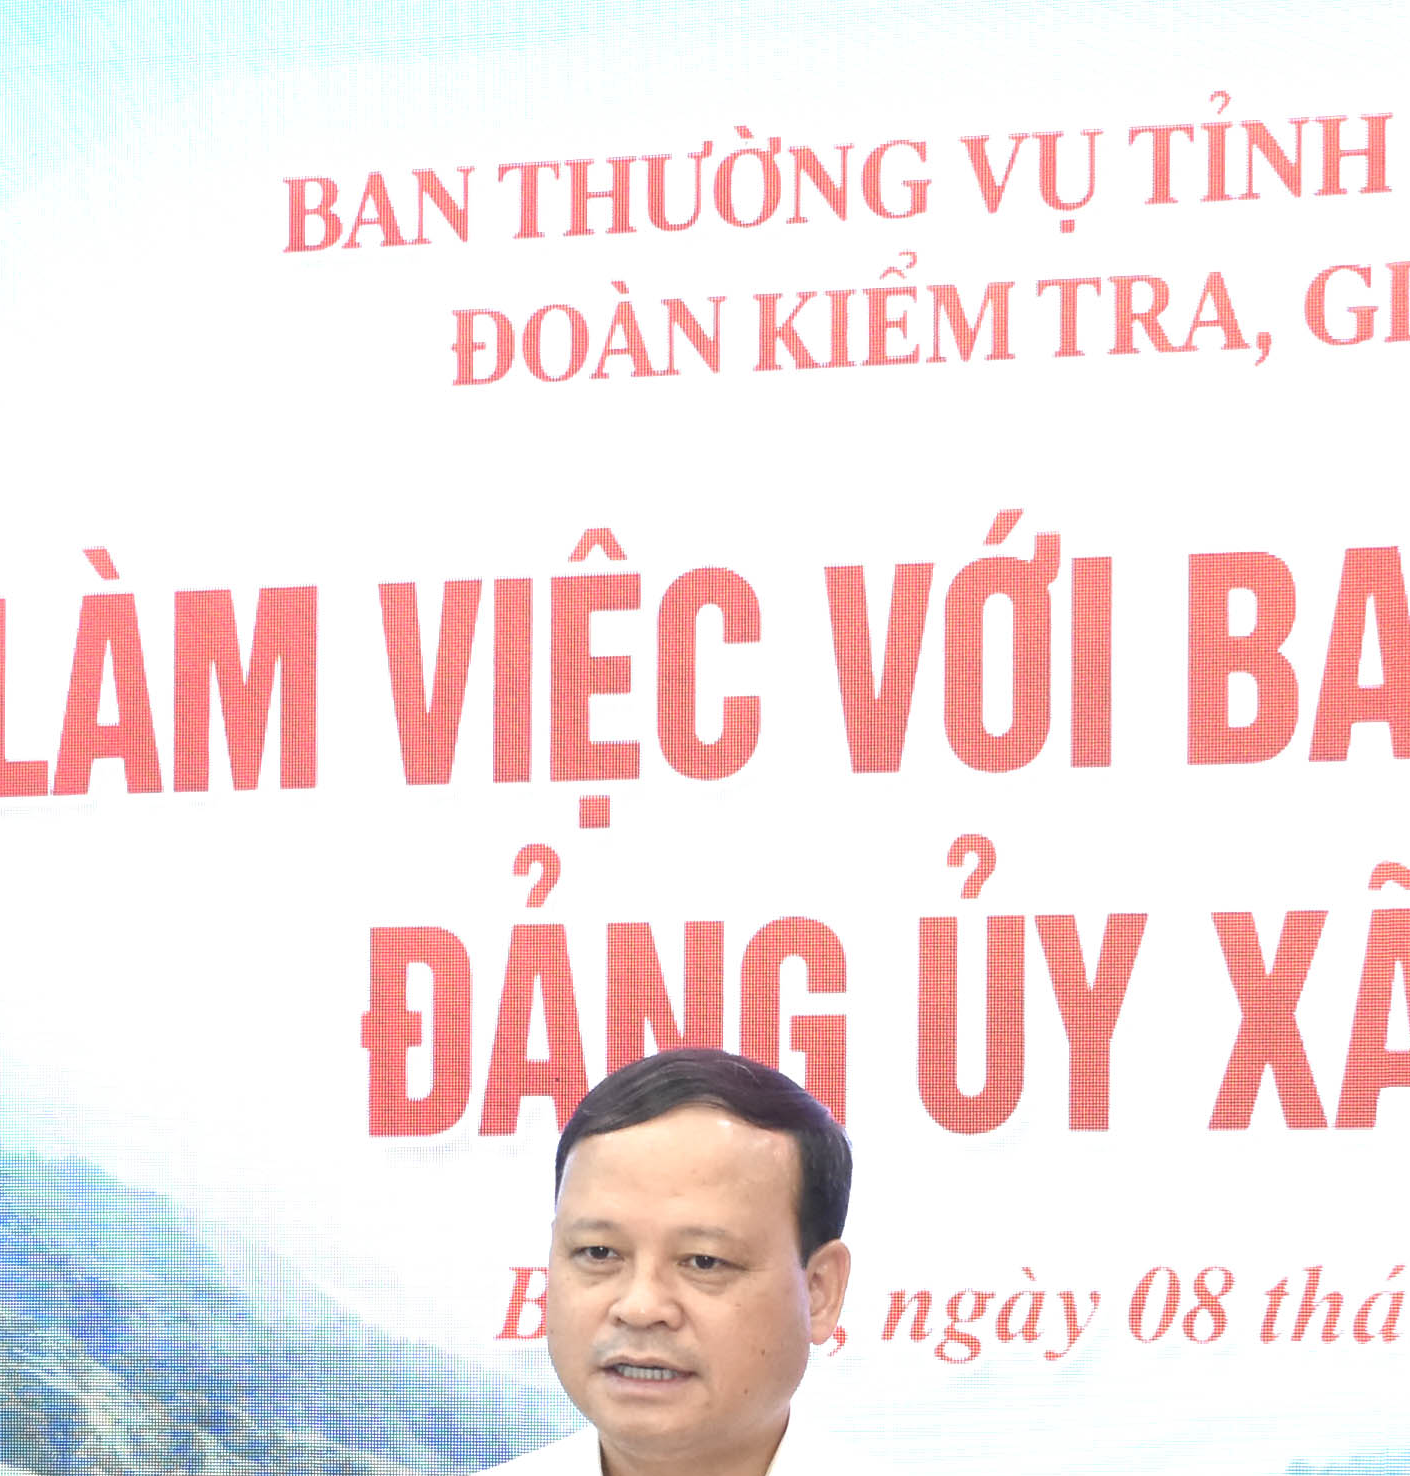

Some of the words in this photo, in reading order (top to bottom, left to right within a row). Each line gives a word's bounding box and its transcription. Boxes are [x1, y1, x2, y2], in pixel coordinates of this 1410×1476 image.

[285, 168, 475, 252] BAN
[498, 126, 931, 239] THƯỜNG
[960, 131, 1101, 233] VỤ
[1130, 91, 1392, 204] TỈNH
[453, 281, 725, 385] ĐOÀN
[754, 252, 1014, 371] KIỂM
[1037, 272, 1272, 366] TRA,
[378, 528, 761, 828] VIỆC
[825, 509, 1112, 773] VỚI
[361, 844, 847, 1136] ĐẢNG
[918, 834, 1148, 1134] ỦY
[882, 1267, 1101, 1363] ngày
[1130, 1267, 1234, 1342] 08
